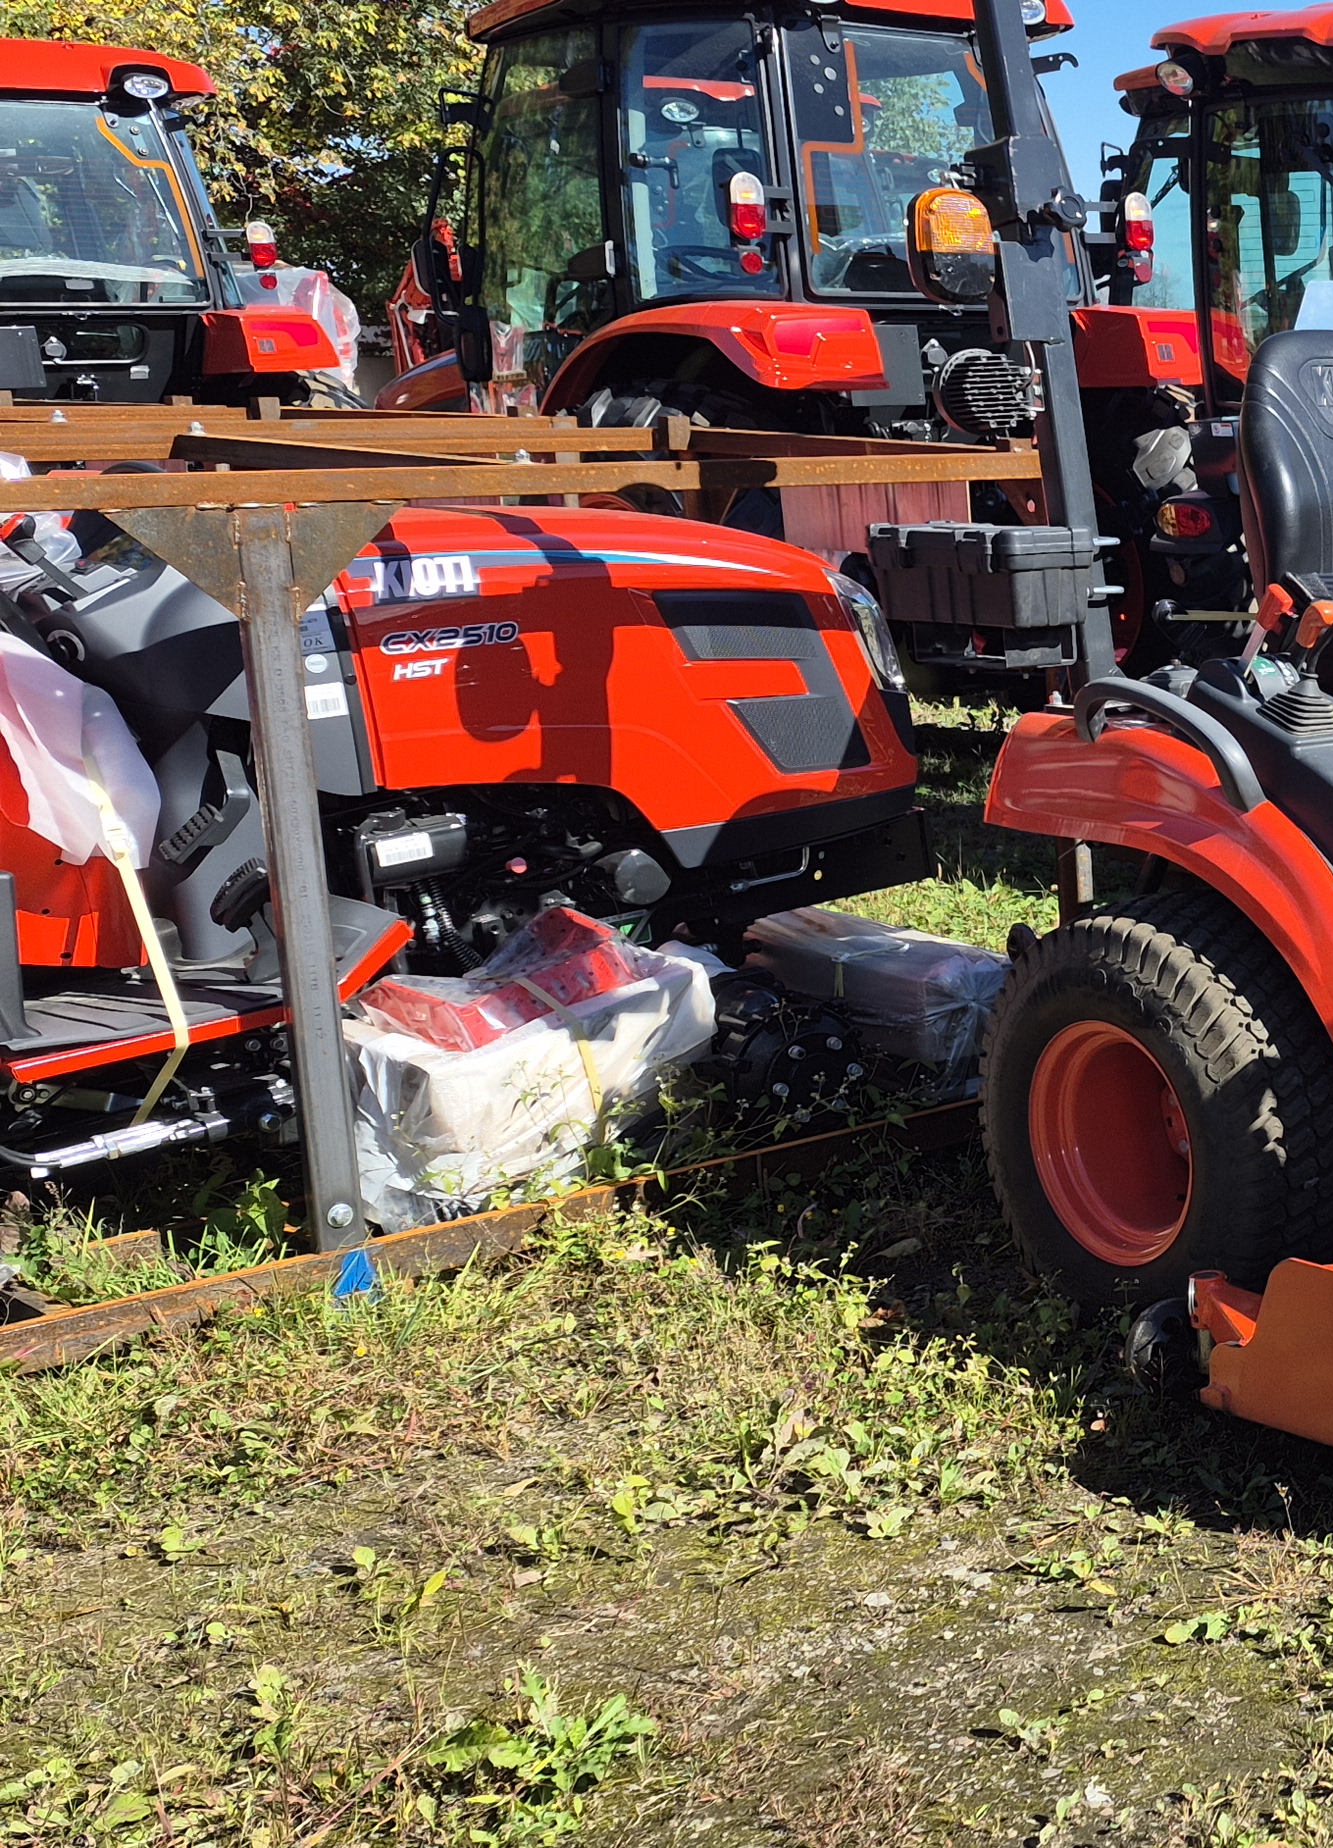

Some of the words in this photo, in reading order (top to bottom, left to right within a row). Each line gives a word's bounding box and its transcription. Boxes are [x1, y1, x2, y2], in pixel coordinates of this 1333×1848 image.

[374, 555, 480, 600] KIOTI
[380, 621, 519, 656] CX2510
[393, 658, 449, 681] HST
